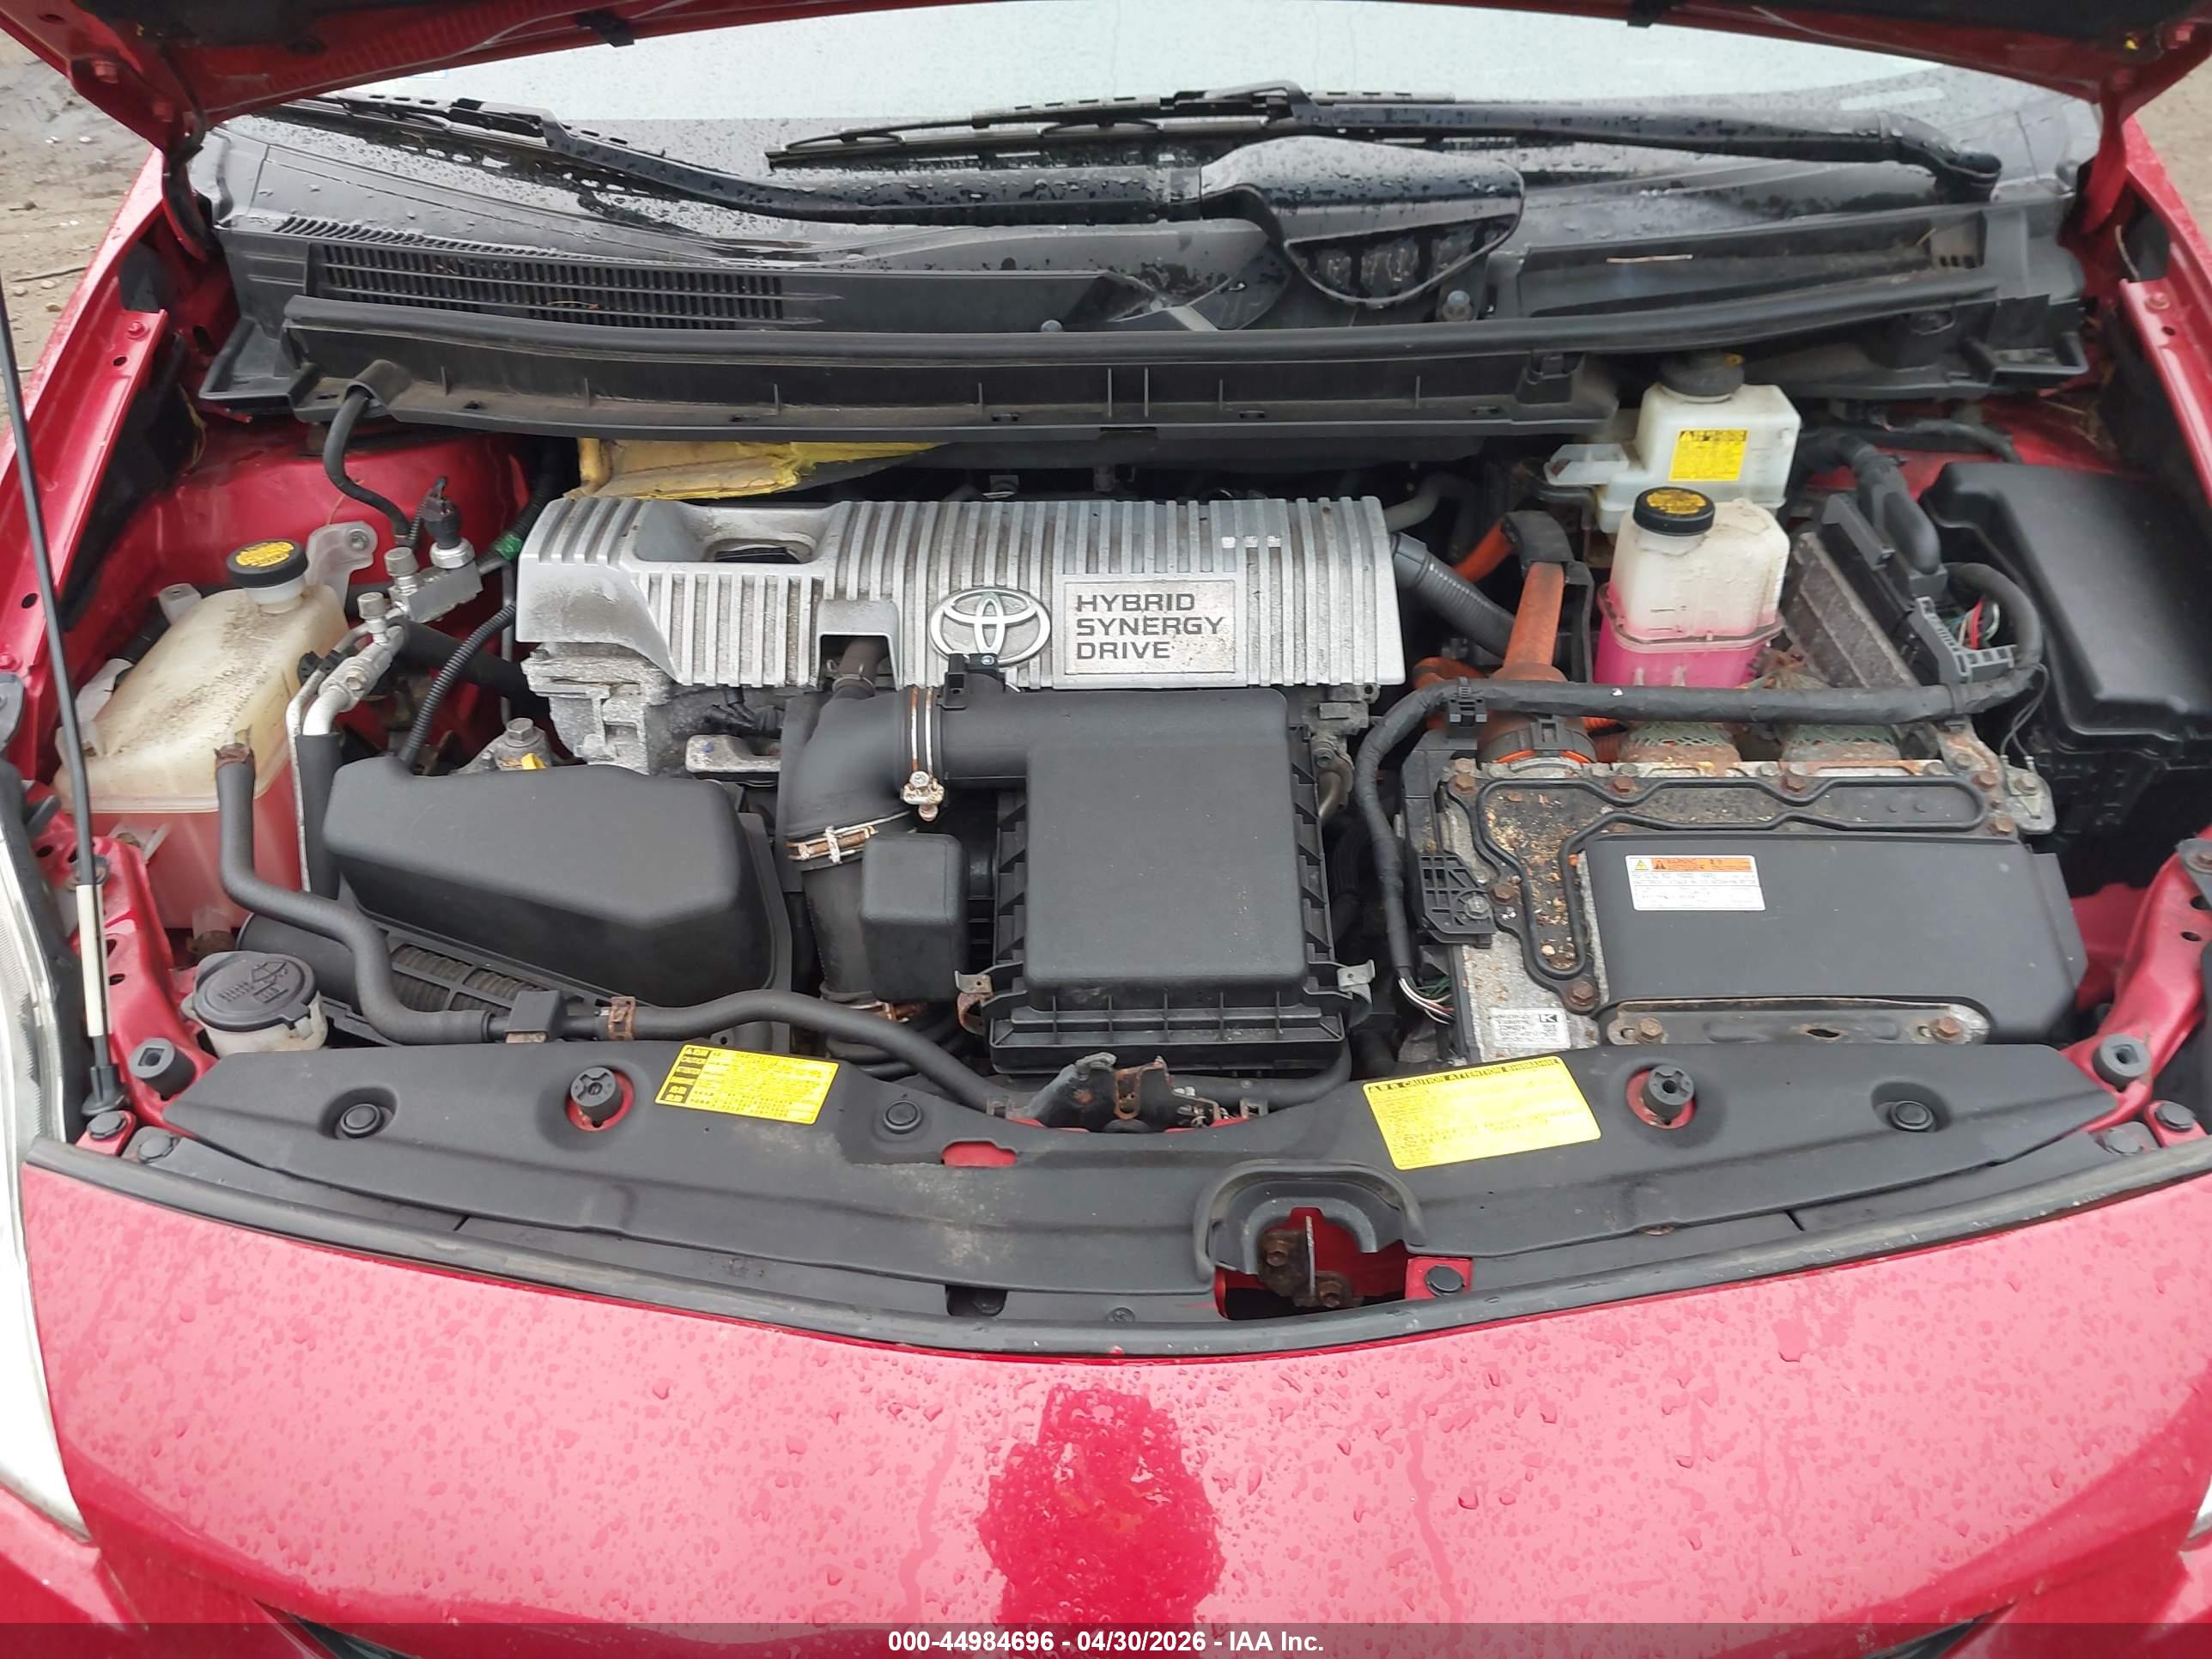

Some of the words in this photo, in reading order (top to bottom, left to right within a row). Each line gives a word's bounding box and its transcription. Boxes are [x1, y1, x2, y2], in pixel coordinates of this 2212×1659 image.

[1077, 593, 1195, 611] HYBRID
[1077, 617, 1224, 636] SYNERGY
[1077, 641, 1170, 659] DRIVE
[1402, 1075, 1446, 1089] CAUTION
